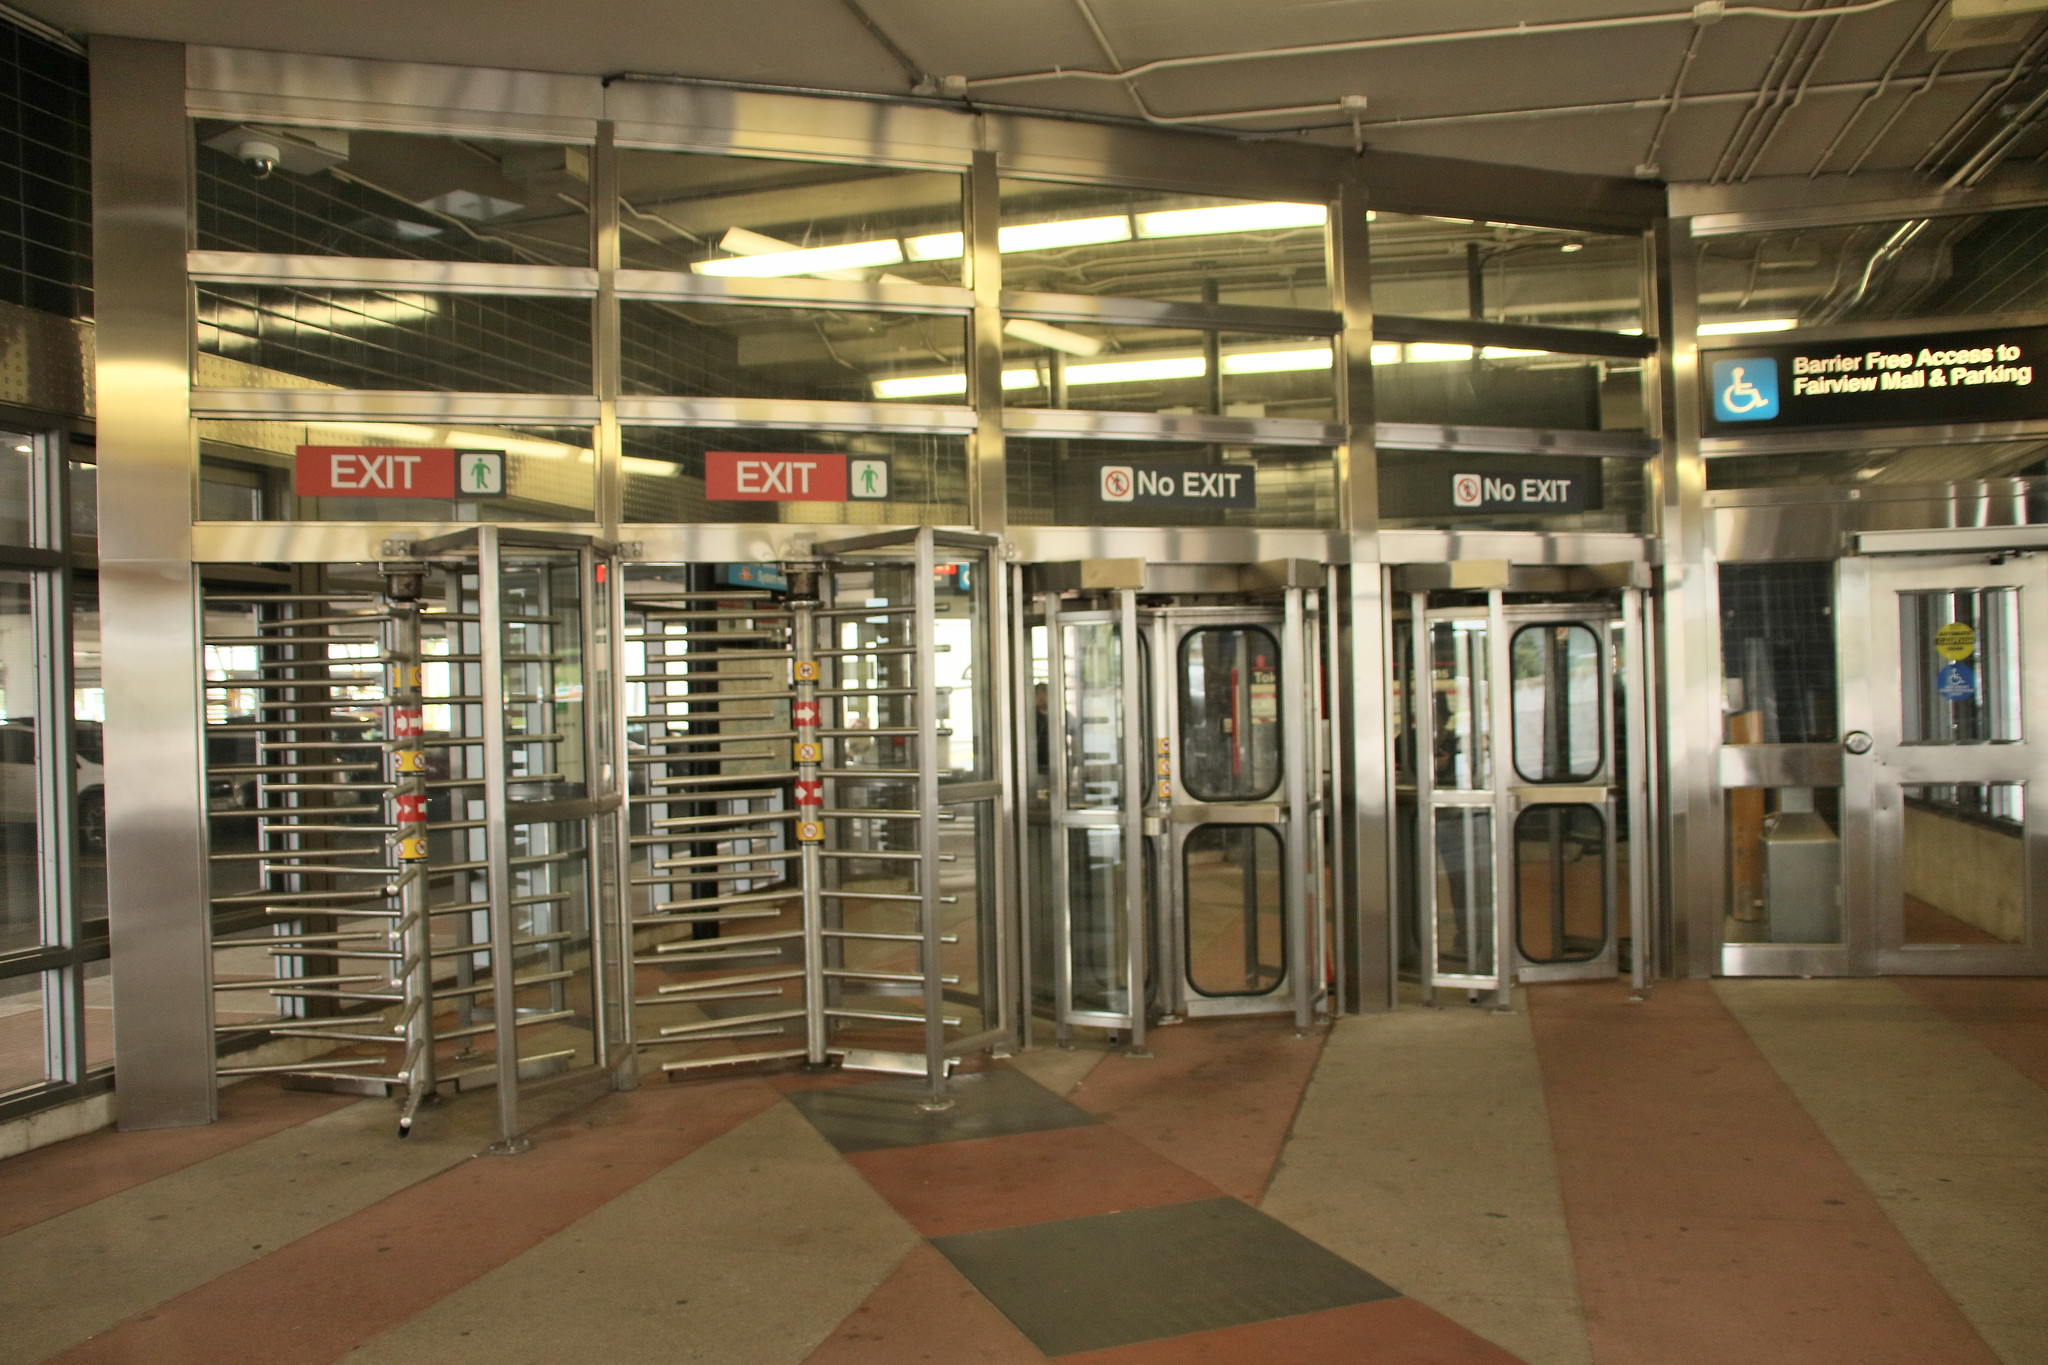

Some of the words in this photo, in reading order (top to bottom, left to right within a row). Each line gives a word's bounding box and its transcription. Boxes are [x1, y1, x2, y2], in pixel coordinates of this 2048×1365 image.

[1793, 355, 1862, 375] Barrier
[1865, 352, 1913, 370] Free
[1916, 347, 1994, 367] Access
[1997, 344, 2021, 362] to
[1793, 373, 1877, 396] Fairview
[1881, 369, 1925, 391] Mall
[1929, 370, 1948, 388] &
[1950, 364, 2032, 387] Parking
[330, 454, 422, 489] EXIT
[736, 461, 817, 494] EXIT
[1137, 470, 1175, 497] No
[1183, 472, 1242, 498] EXIT
[1483, 478, 1516, 502] No
[1521, 479, 1572, 503] EXIT
